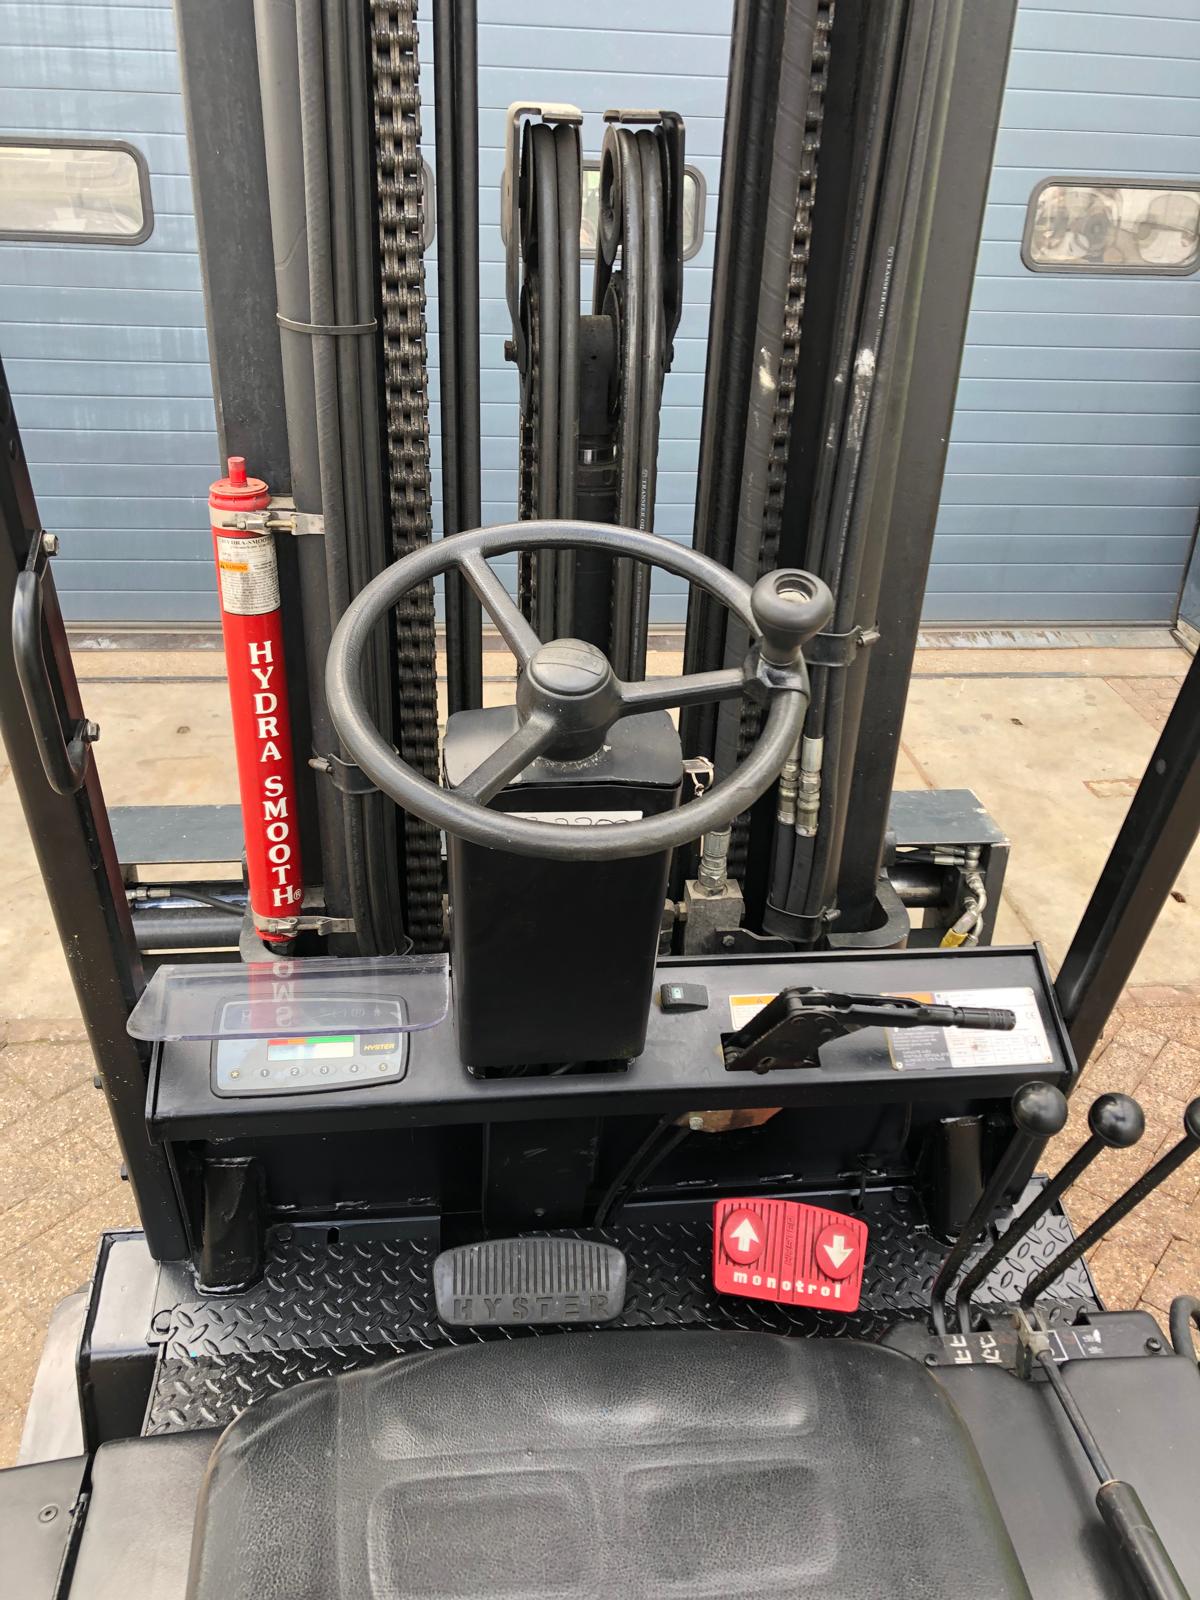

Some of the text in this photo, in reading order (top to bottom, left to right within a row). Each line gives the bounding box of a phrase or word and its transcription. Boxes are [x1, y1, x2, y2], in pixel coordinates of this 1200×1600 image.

[880, 259, 892, 302] TRANSFER
[248, 640, 283, 763] HYDRA
[363, 1042, 396, 1051] HYSTER
[733, 1271, 841, 1299] monotrol
[453, 1294, 610, 1321] HYSTER
